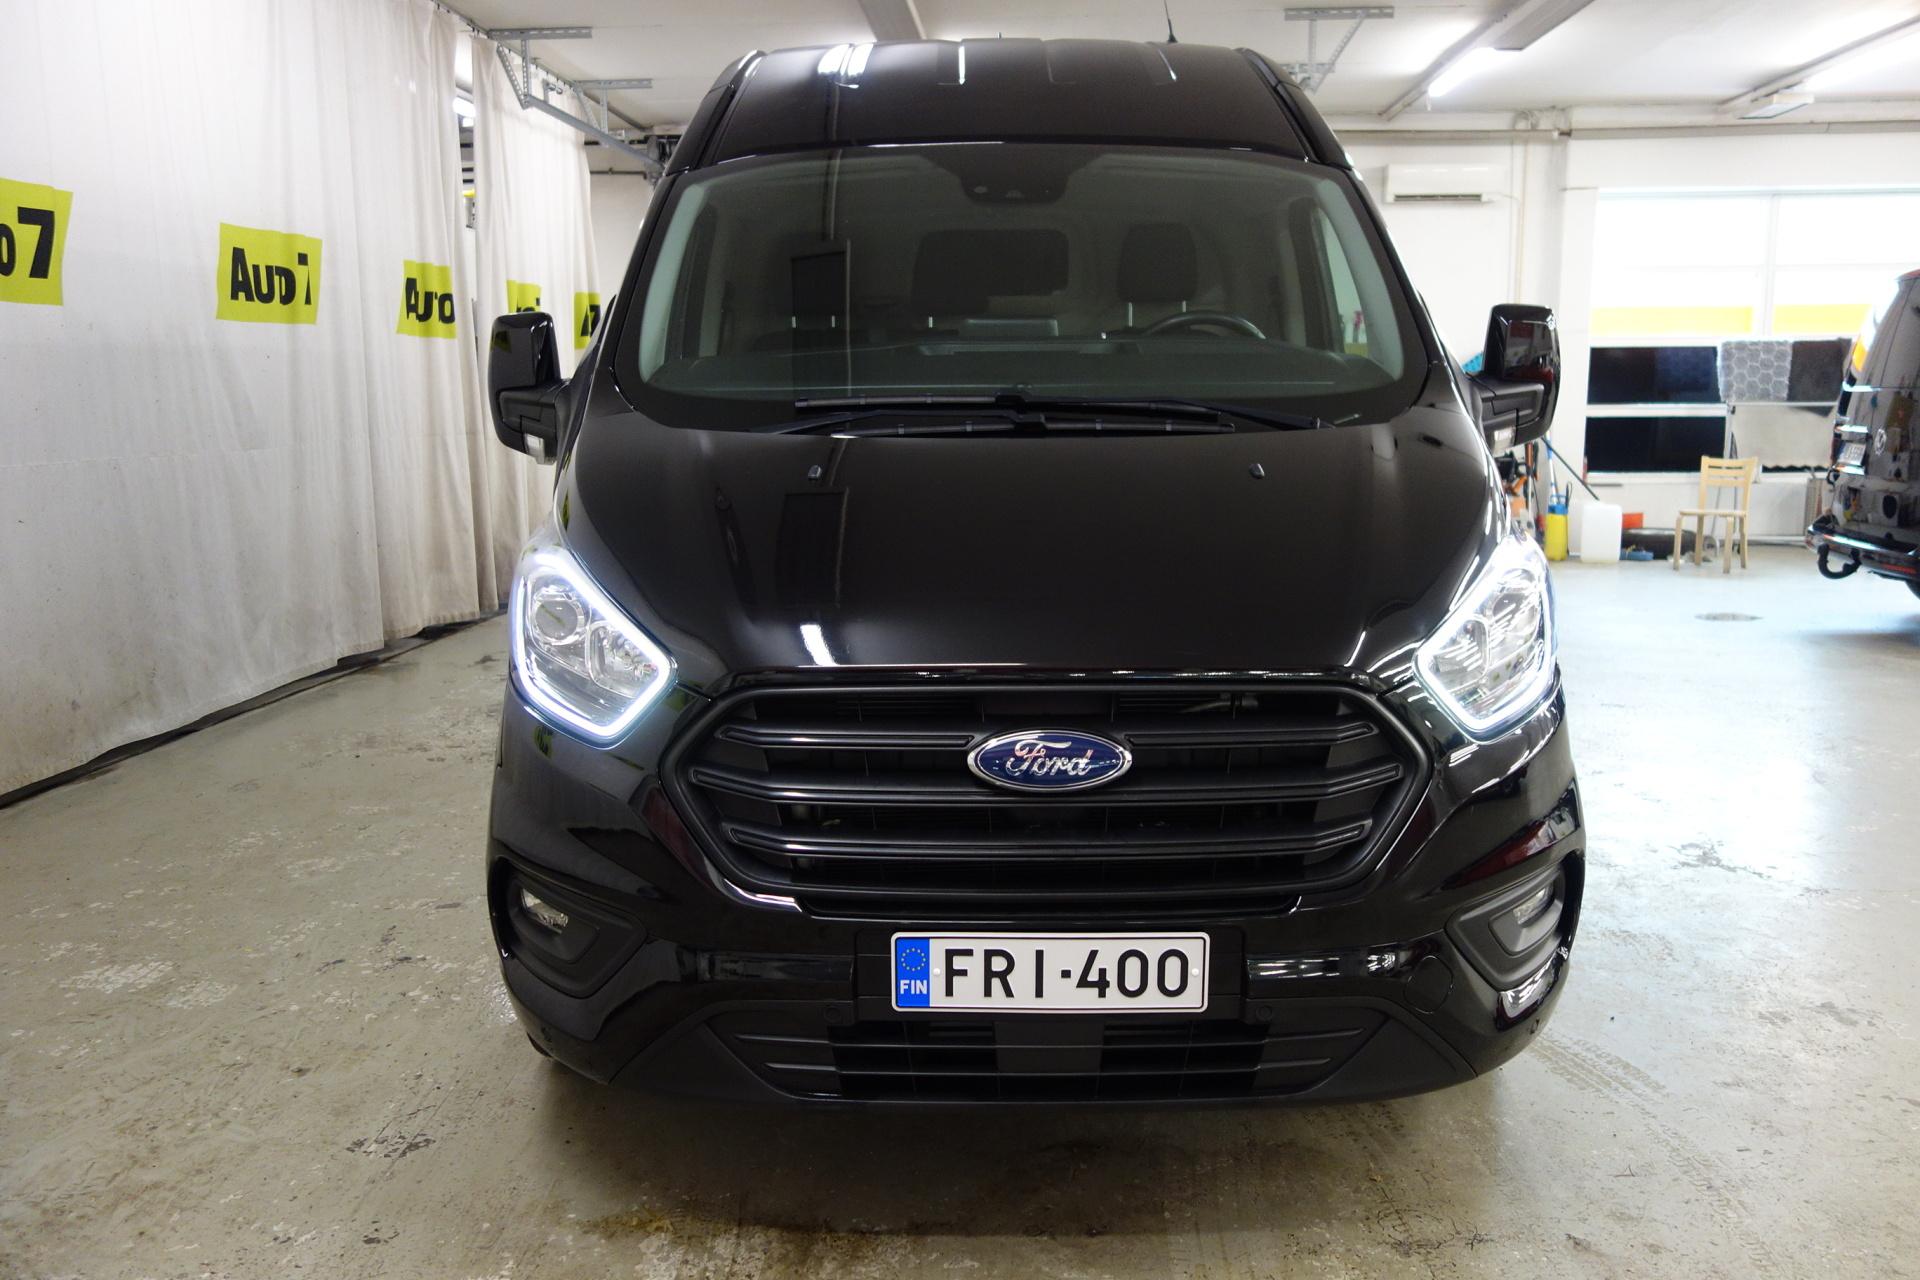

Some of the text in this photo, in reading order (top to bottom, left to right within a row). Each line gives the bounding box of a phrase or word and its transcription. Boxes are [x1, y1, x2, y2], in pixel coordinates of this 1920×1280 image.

[1005, 739, 1094, 776] Ford
[900, 979, 928, 995] FIN
[944, 948, 1190, 999] FRI-400
